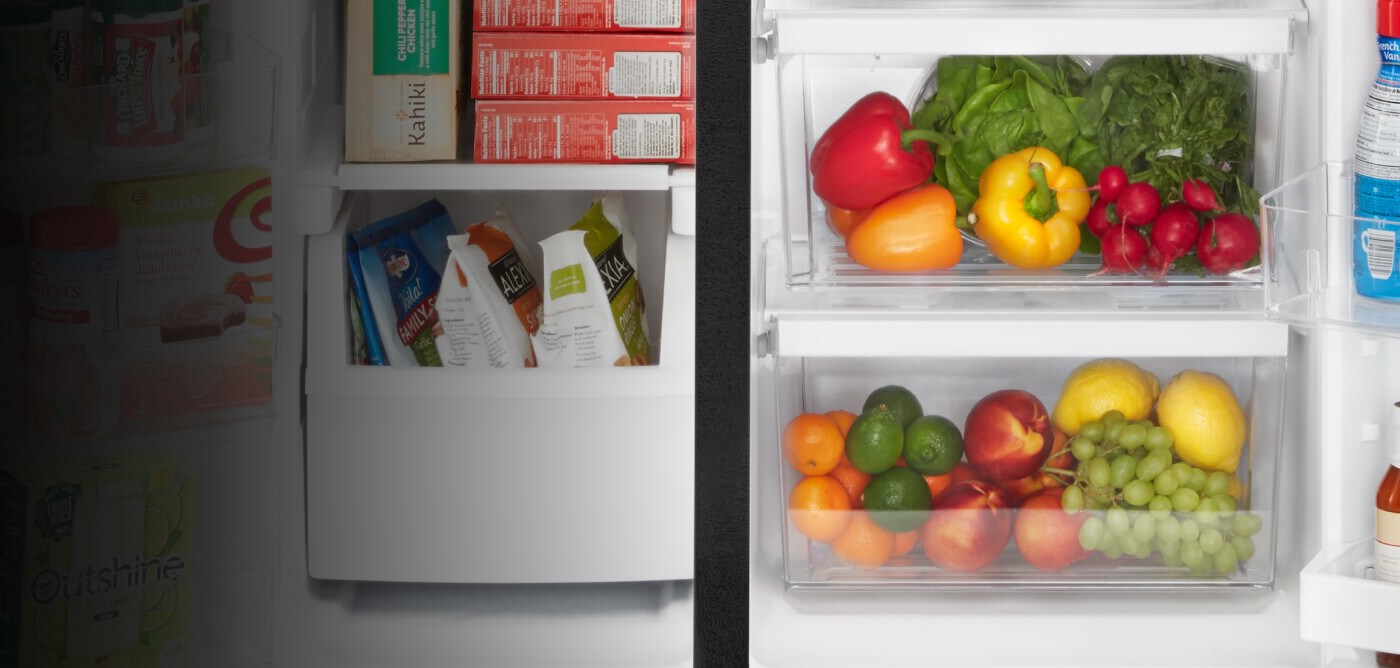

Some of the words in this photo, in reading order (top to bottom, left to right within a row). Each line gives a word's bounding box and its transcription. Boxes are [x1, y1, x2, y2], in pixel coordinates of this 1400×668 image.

[397, 36, 407, 61] CHILI
[407, 9, 416, 53] CHICKEN
[57, 32, 68, 80] ORCHARD
[116, 52, 132, 120] ORCHARD
[130, 84, 148, 128] 100%
[408, 82, 426, 146] Kahiki
[134, 232, 175, 245] Vanilla
[135, 247, 201, 262] Strawberry
[135, 262, 194, 275] Jubilation
[399, 303, 428, 343] FAMILY
[46, 496, 73, 517] FRUIT
[31, 554, 185, 605] Outshine
